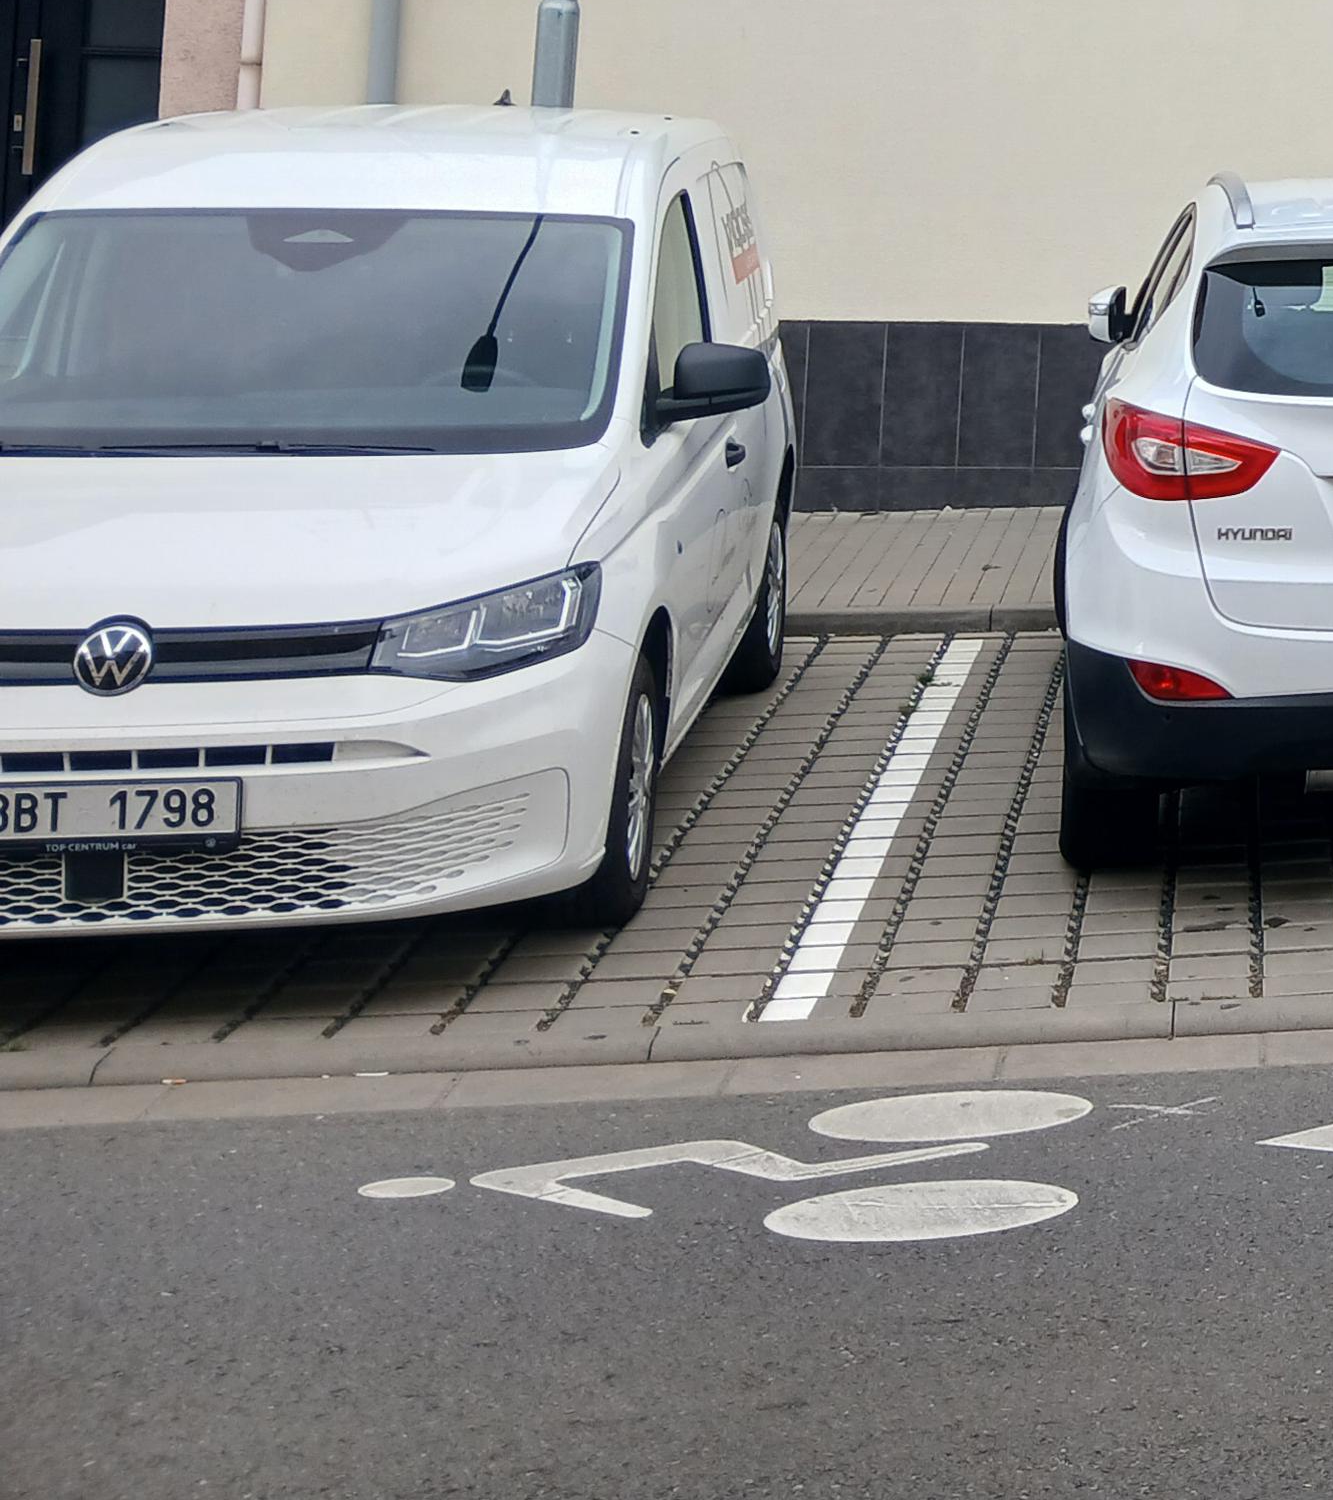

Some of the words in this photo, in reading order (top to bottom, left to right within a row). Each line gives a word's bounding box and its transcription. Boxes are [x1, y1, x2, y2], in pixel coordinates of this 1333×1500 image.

[1217, 528, 1293, 541] HYUNDAI
[109, 787, 216, 830] 1798
[45, 843, 68, 853] TOP
[70, 841, 119, 852] CENTRUM
